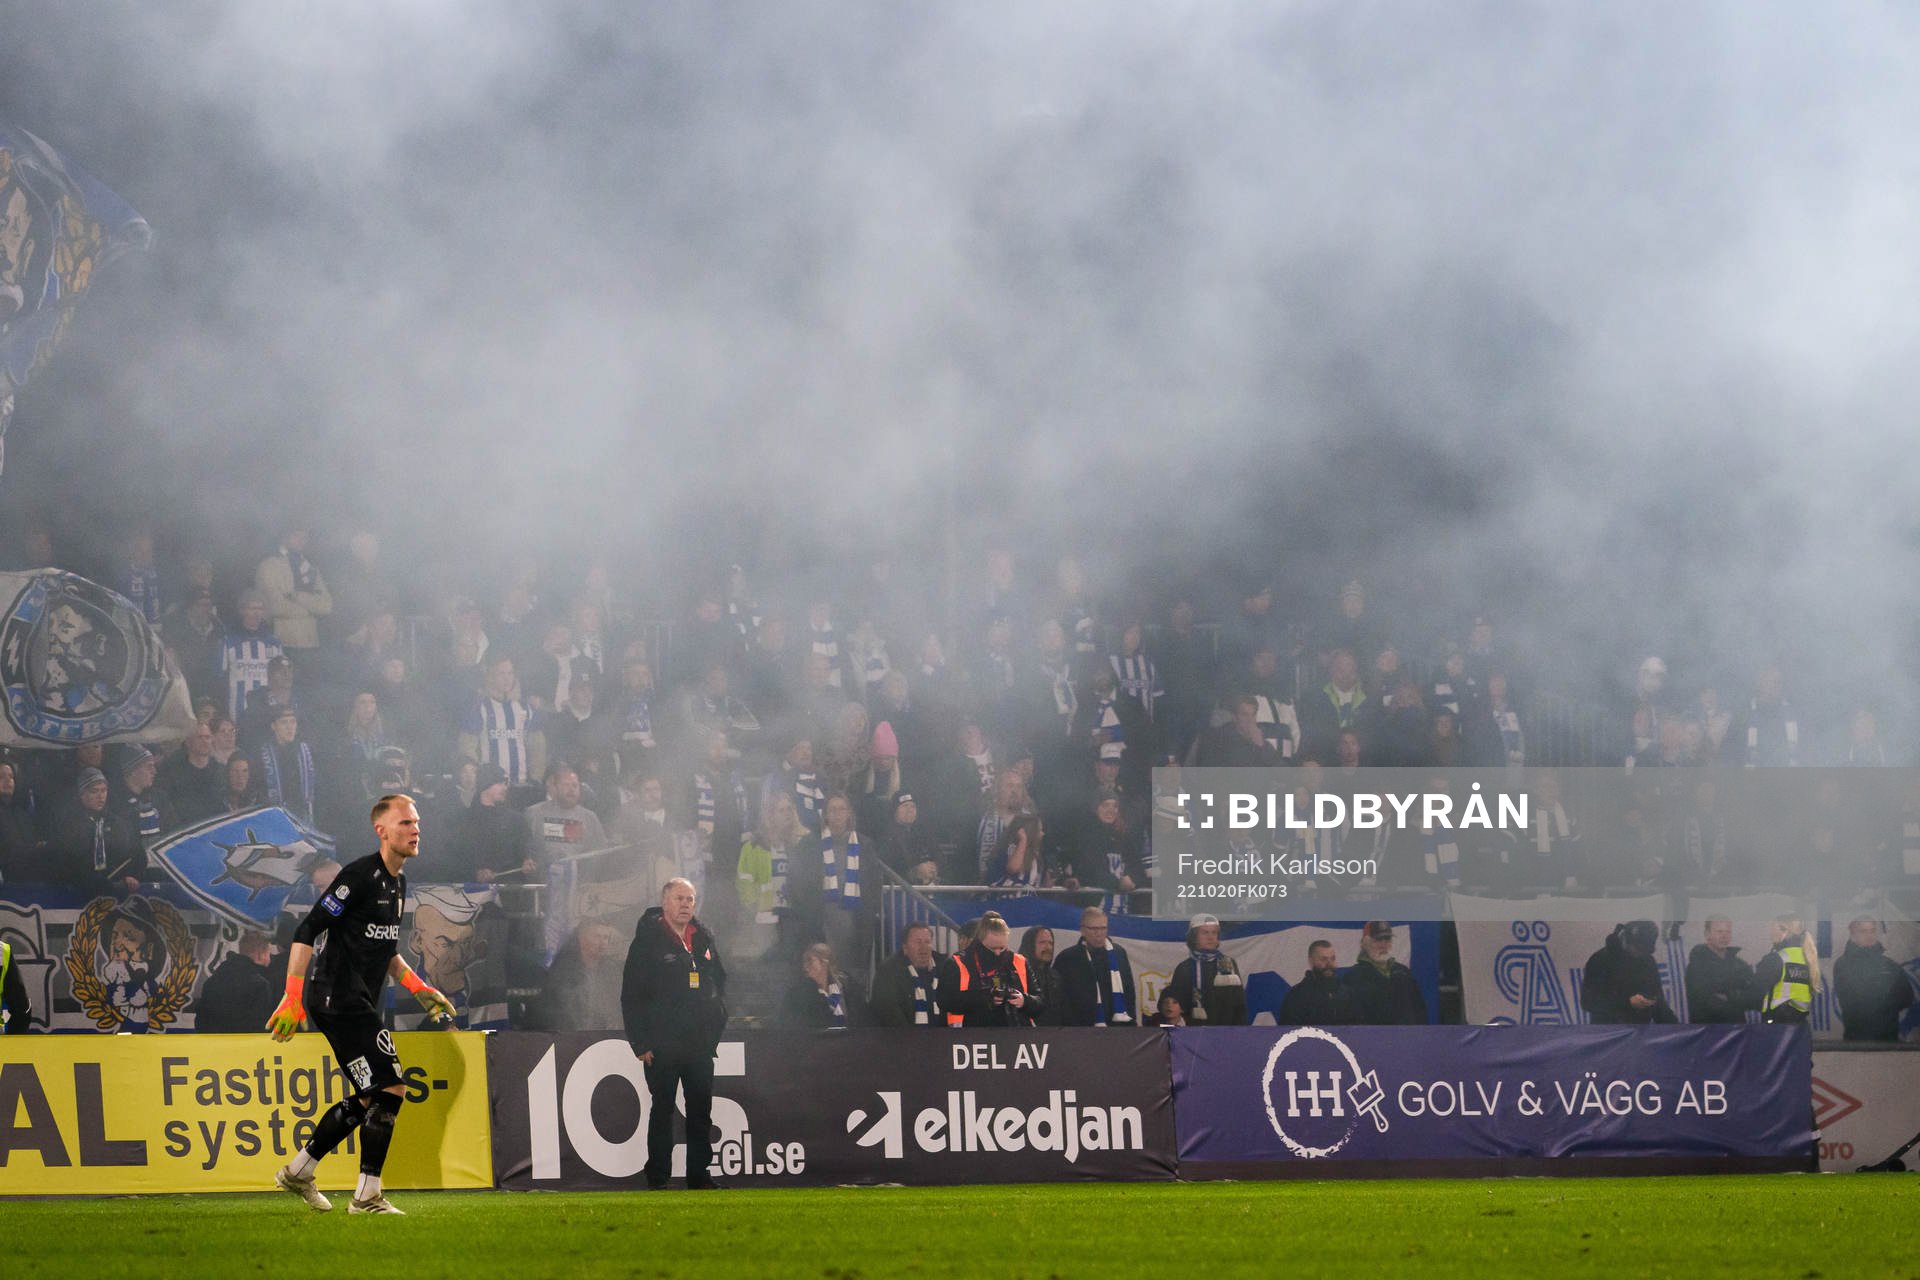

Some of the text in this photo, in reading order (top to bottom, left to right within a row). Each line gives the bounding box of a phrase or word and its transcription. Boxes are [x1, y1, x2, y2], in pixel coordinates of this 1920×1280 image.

[162, 1056, 448, 1117] Fastighs-
[952, 1043, 1049, 1070] DEL AV
[0, 1063, 148, 1168] AL
[1398, 1071, 1729, 1116] GOLV & VÄGG AB
[914, 1090, 1144, 1164] elkedjan
